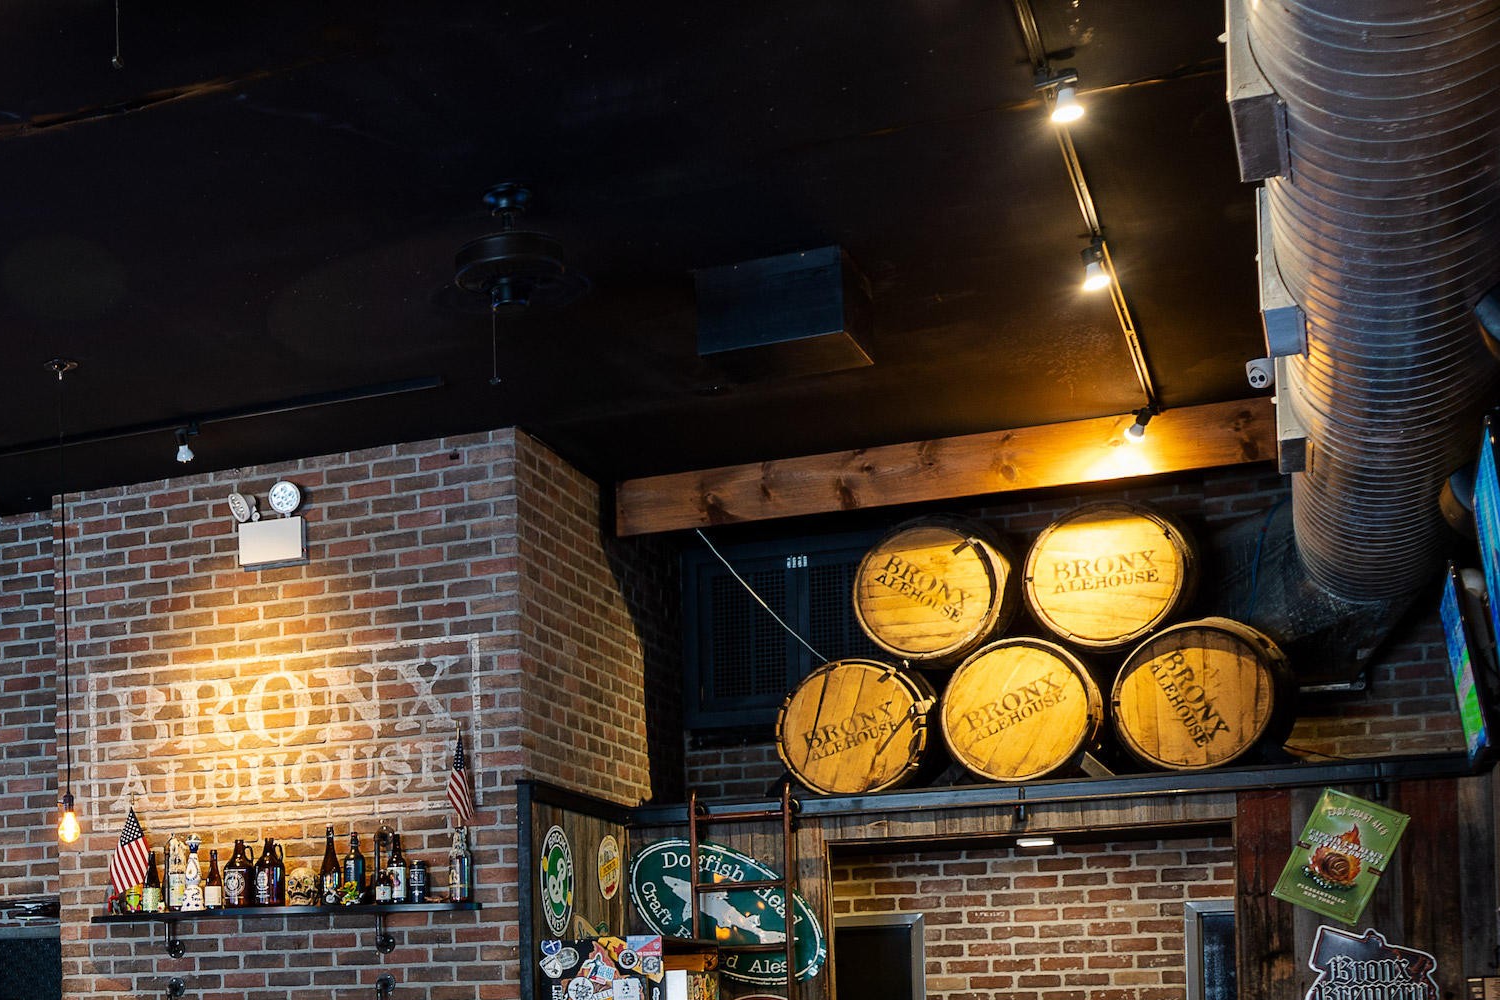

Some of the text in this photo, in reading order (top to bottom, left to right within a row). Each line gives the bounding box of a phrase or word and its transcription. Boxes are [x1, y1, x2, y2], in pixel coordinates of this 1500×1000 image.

[880, 552, 972, 608] BRONX
[1052, 550, 1156, 579] BRONX
[1053, 568, 1159, 594] ALEHOUSE
[875, 572, 964, 623] ALEHOUSE
[114, 655, 460, 757] BRONX
[963, 671, 1066, 732] BRONX
[972, 689, 1067, 741] ALEHOUSE
[1150, 661, 1208, 748] ALEHOUSE
[1161, 651, 1231, 740] BRONX
[801, 700, 894, 748] BRONX
[810, 719, 900, 762] ALEHOUSE
[110, 741, 456, 810] ALEHOUSE
[1328, 807, 1388, 836] EAST COAST ALES
[641, 882, 672, 925] Craft
[1297, 883, 1347, 904] PLEASANTVILLE
[1302, 890, 1317, 899] NEW
[1326, 954, 1412, 984] Bronx
